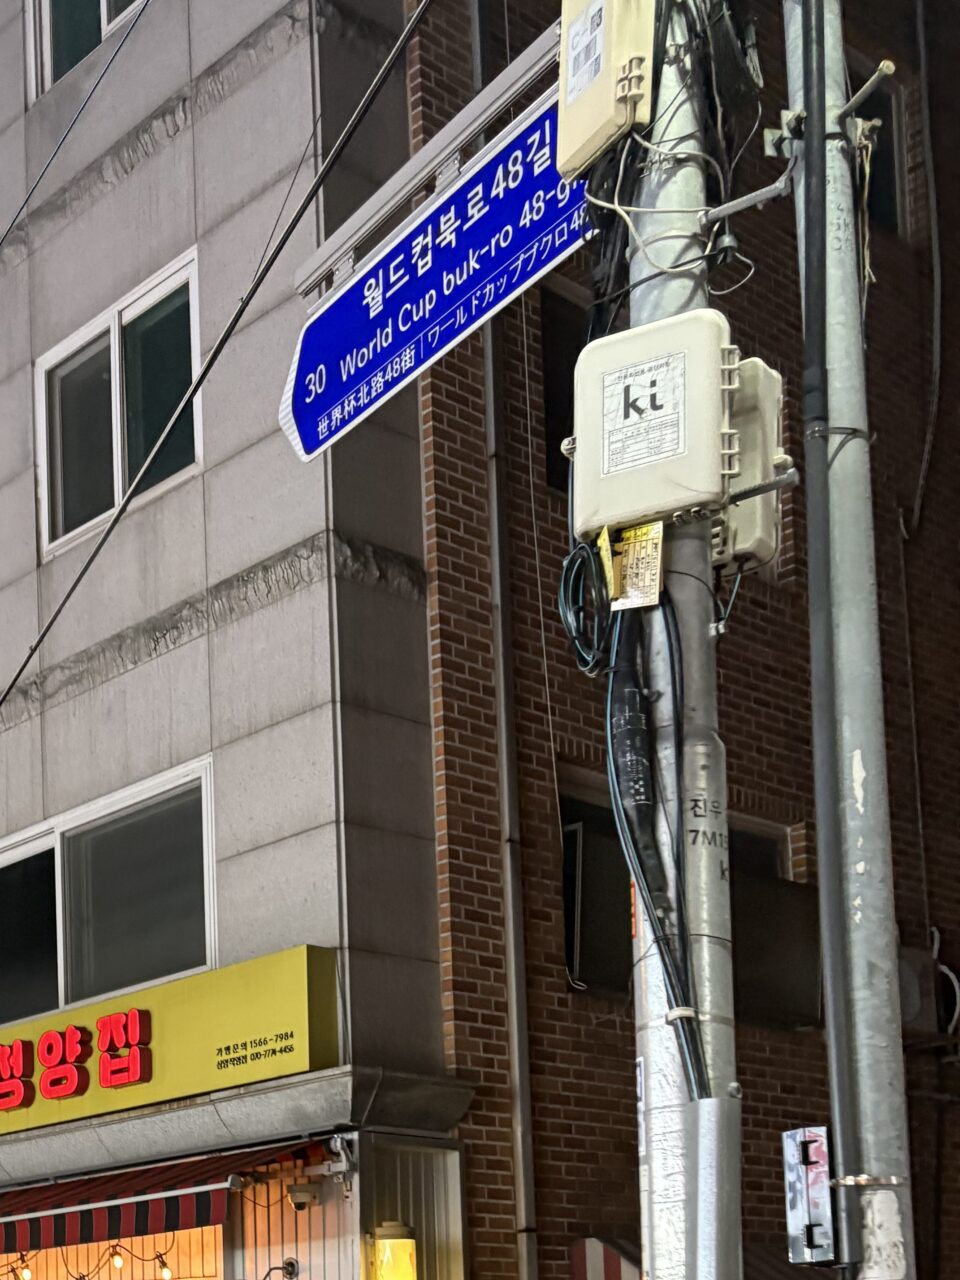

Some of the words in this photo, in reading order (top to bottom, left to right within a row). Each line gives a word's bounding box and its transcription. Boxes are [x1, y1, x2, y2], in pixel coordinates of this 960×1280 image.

[304, 363, 327, 404] 30
[339, 320, 392, 383] World
[398, 288, 436, 332] Cup
[442, 225, 512, 293] buk-ro
[250, 1031, 294, 1049] 1566-7984
